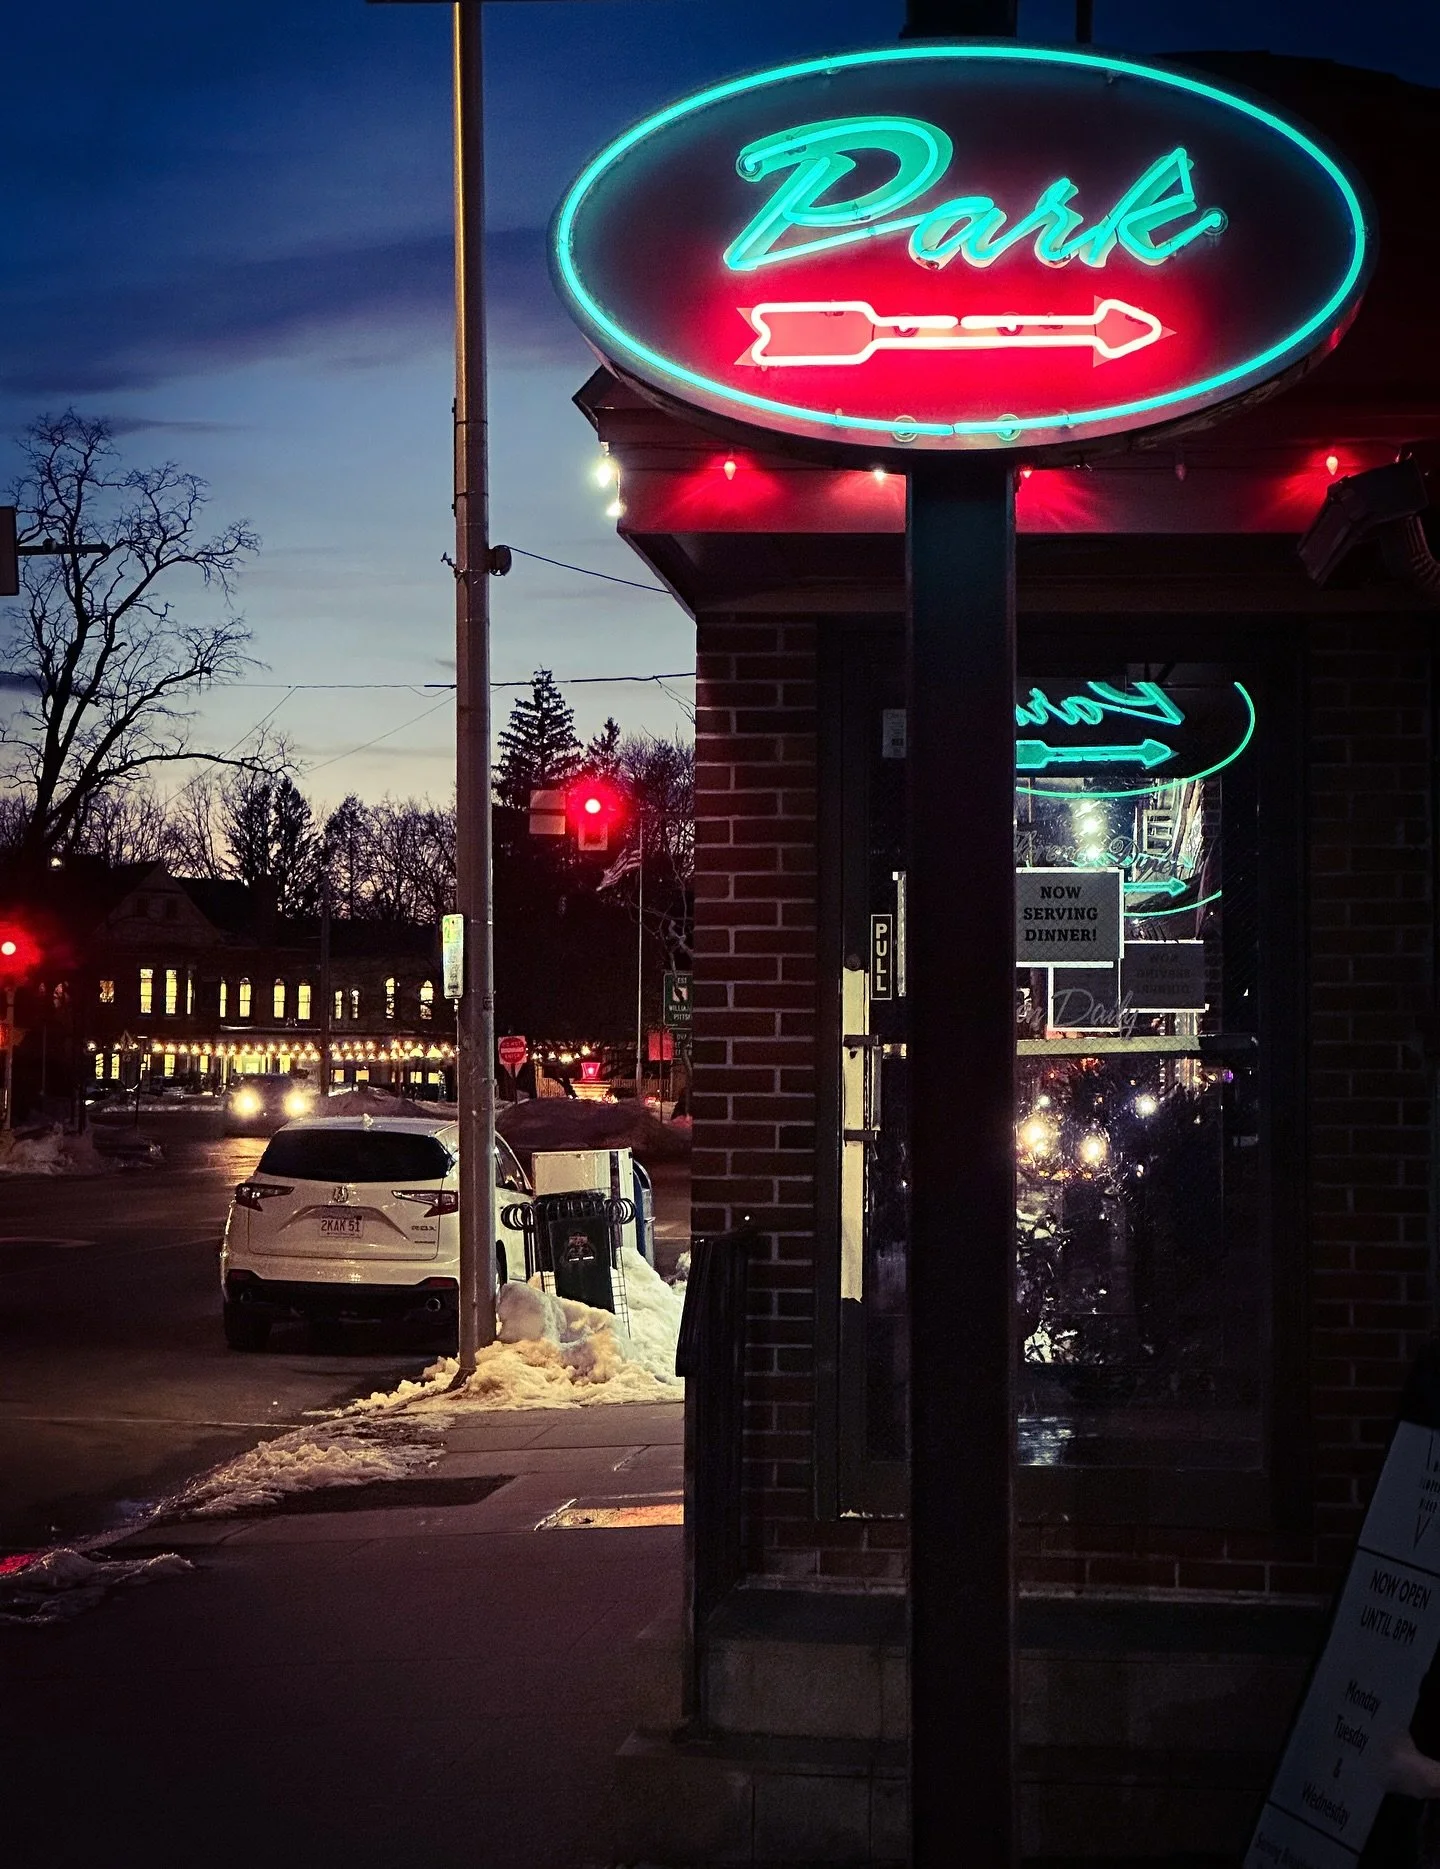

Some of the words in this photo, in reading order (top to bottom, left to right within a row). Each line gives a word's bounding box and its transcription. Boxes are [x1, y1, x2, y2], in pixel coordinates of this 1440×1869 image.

[724, 116, 1227, 270] Park
[1040, 886, 1082, 899] NOW
[1023, 907, 1098, 920] SERVING
[1025, 929, 1097, 942] DINNER!
[875, 923, 888, 991] PULL
[1053, 988, 1140, 1040] Daily
[321, 1219, 346, 1232] 2KAK
[348, 1219, 360, 1232] 51
[1370, 1569, 1402, 1594] NOW
[1399, 1581, 1432, 1612] OPEN
[1360, 1605, 1392, 1636] UNTIL
[1393, 1614, 1418, 1645] 8PM
[1344, 1680, 1382, 1721] Monday
[1334, 1714, 1370, 1756] Tuesday
[1301, 1781, 1351, 1832] Wednesday
